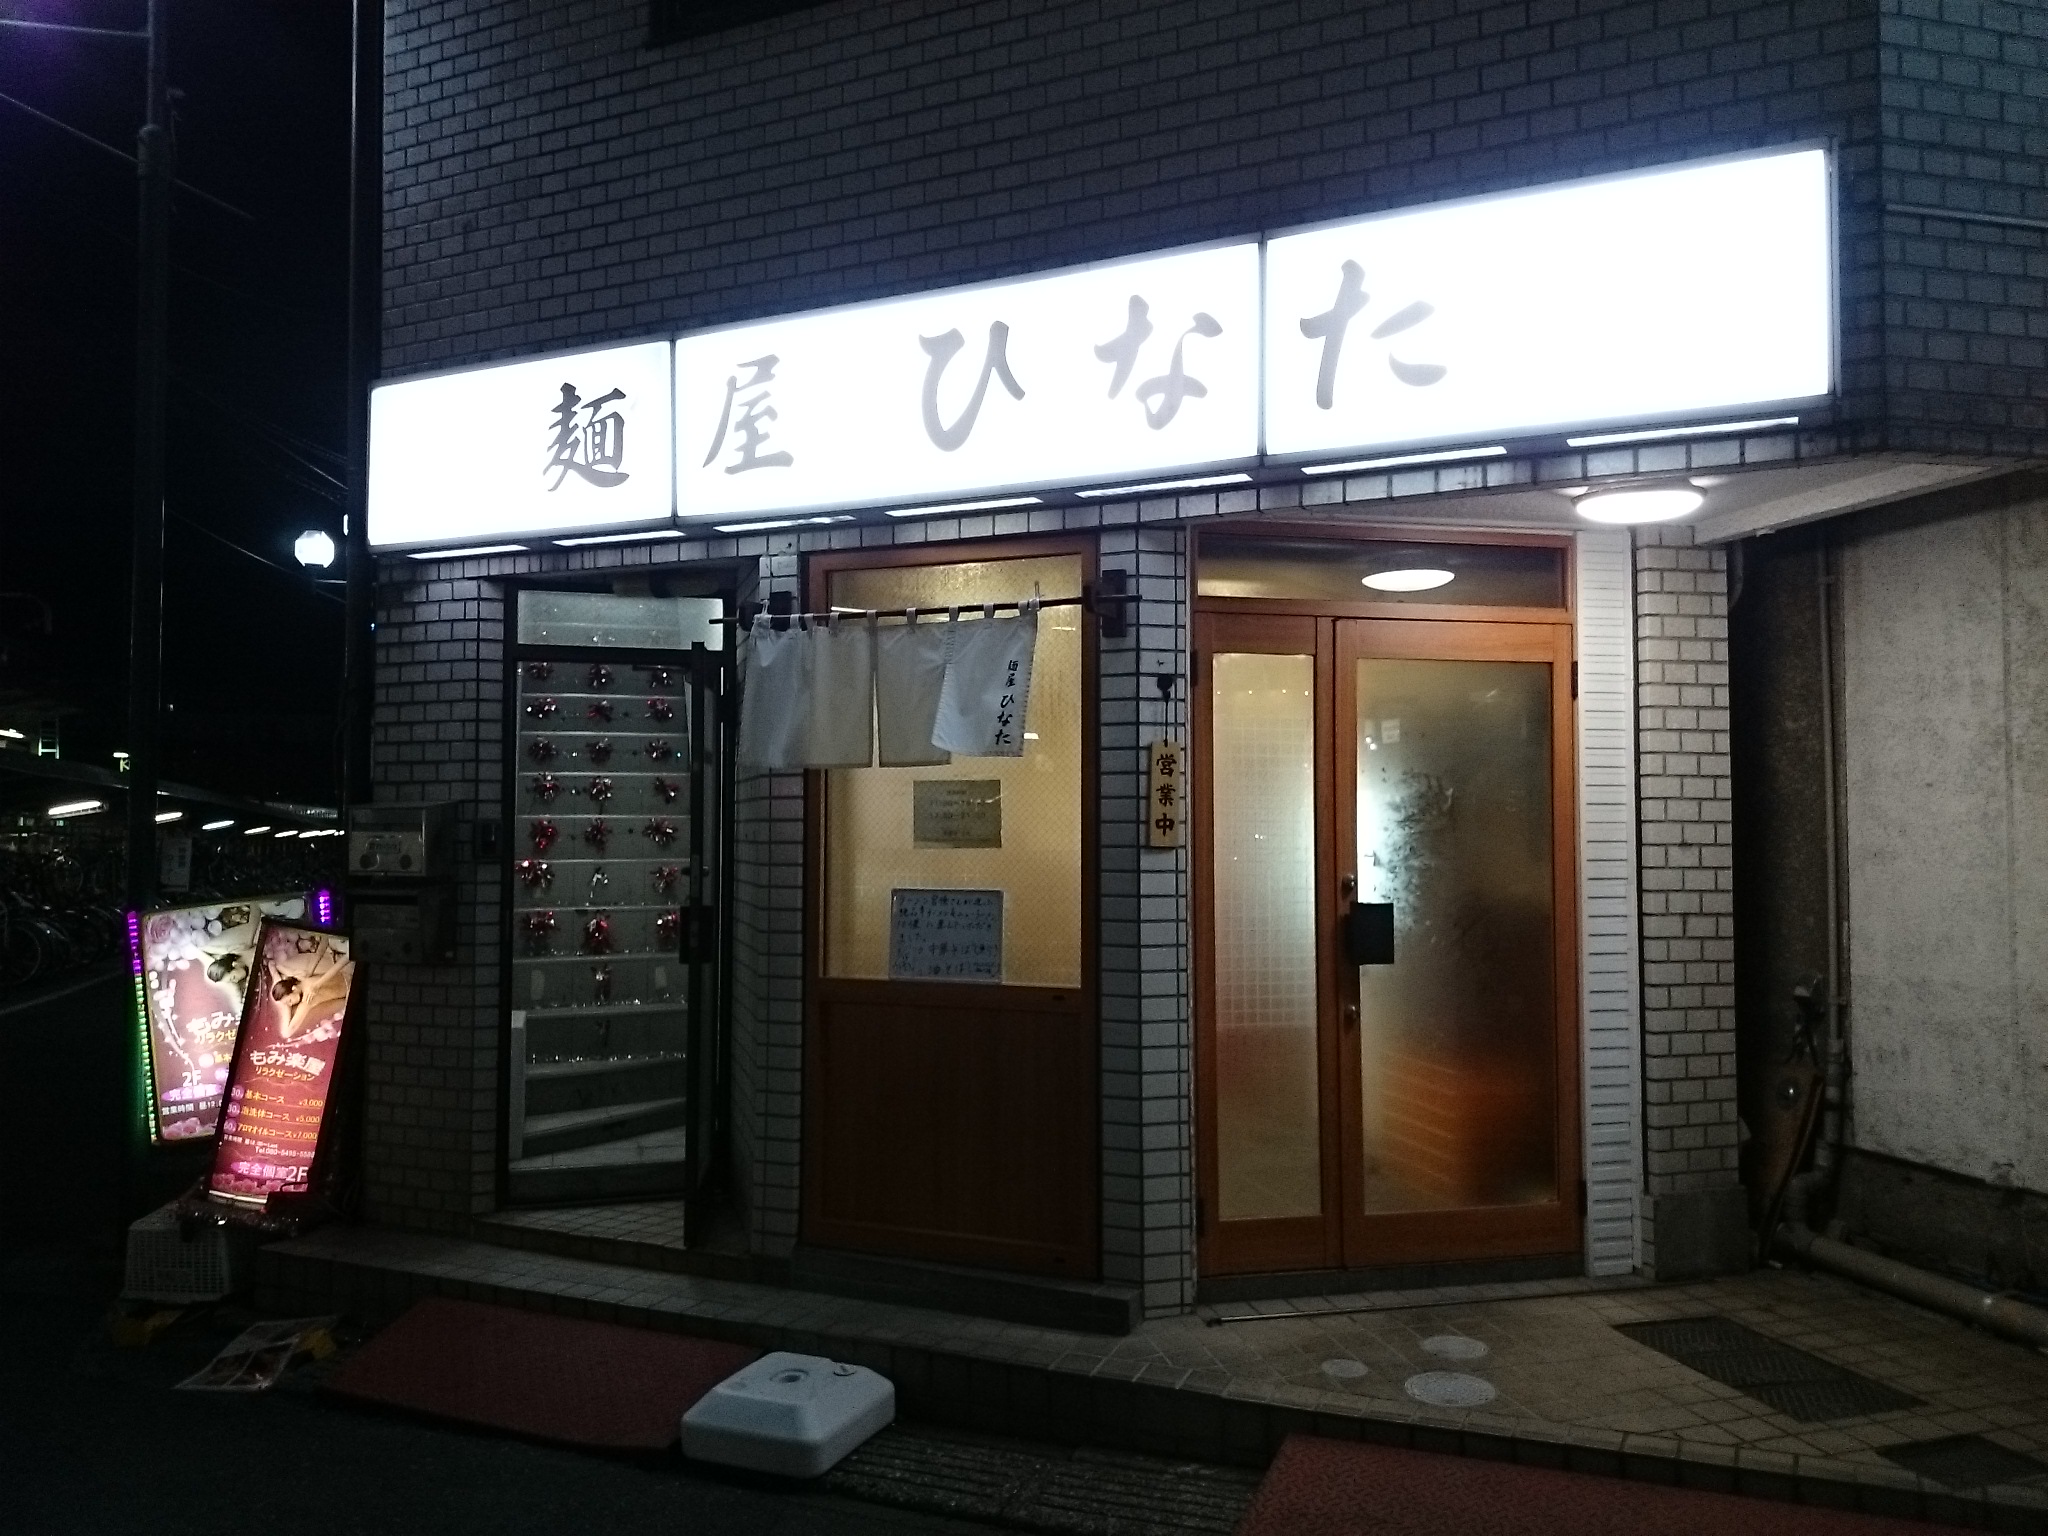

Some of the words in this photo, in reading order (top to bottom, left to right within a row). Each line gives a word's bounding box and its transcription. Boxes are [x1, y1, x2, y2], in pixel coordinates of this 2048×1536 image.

[545, 260, 1448, 493] 麺屋ひなた
[1154, 753, 1178, 837] 営業中
[249, 1049, 326, 1076] もみ楽屋
[181, 1069, 202, 1087] 2F
[255, 1066, 316, 1081] リラクゼーション
[245, 1088, 285, 1104] 基本コース
[238, 1161, 288, 1178] 完全個室
[286, 1165, 309, 1182] 2F
